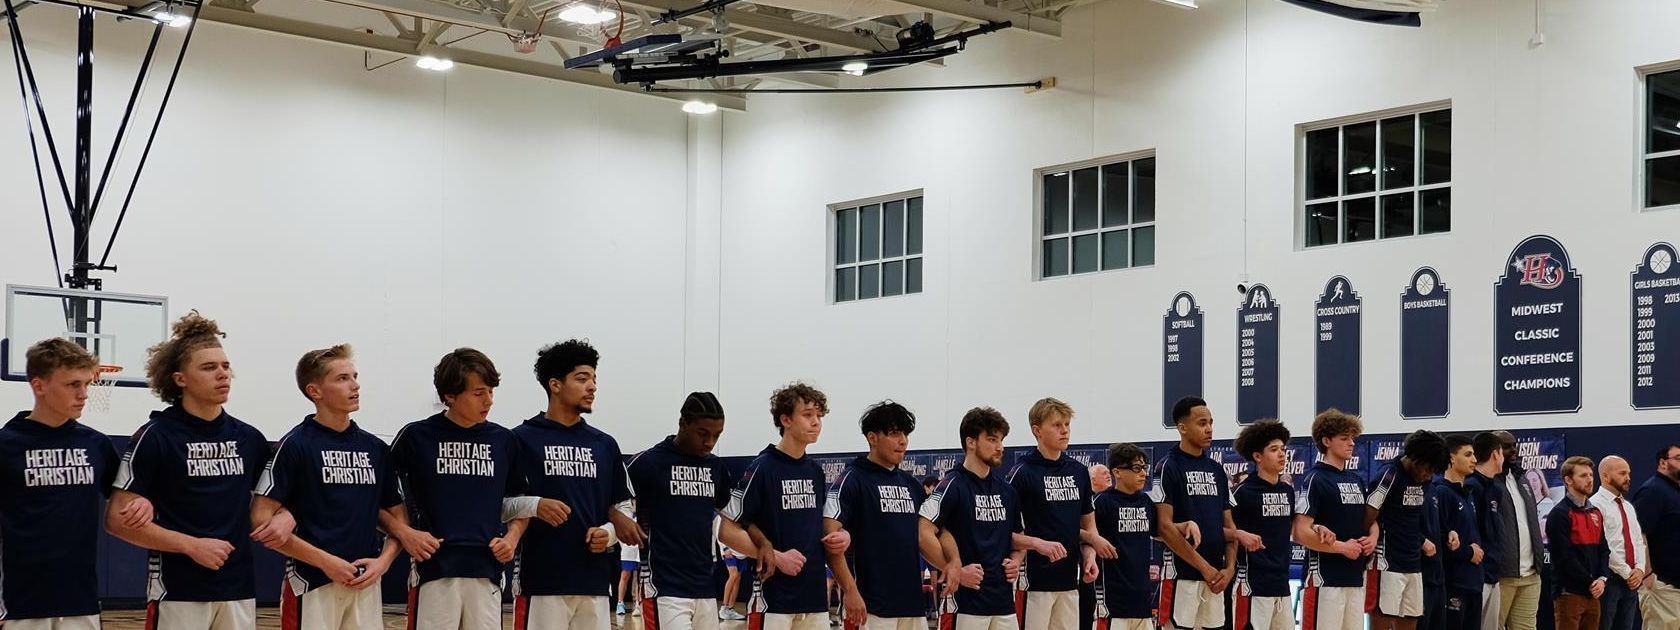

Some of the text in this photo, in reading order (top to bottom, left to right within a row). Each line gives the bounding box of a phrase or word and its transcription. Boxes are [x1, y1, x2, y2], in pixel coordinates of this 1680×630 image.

[1635, 280, 1650, 289] GIRLS
[1404, 299, 1446, 309] BOYS BASKETBALL
[1664, 293, 1680, 303] 2013
[1317, 305, 1360, 316] CROSS COUNTRY
[1511, 303, 1563, 316] MIDWEST
[1637, 307, 1653, 317] 1999
[1172, 320, 1195, 329] SOFTBALL
[1244, 313, 1272, 323] WRESTLING
[1637, 319, 1655, 329] 2000
[1242, 329, 1254, 337] 2000
[1514, 328, 1559, 341] CLASSIC
[1637, 330, 1653, 340] 2001
[1242, 339, 1254, 347] 2004
[1637, 342, 1655, 352] 2003
[1242, 348, 1254, 357] 2005
[1501, 352, 1574, 366] CONFERENCE
[1637, 353, 1655, 363] 2009
[1242, 368, 1254, 376] 2007
[1637, 365, 1651, 375] 2011
[1504, 377, 1570, 390] CHAMPIONS
[1637, 377, 1653, 387] 2012
[187, 441, 240, 459] HERITAGE
[439, 442, 491, 460] HERITAGE
[544, 446, 594, 463] HERITAGE
[1374, 446, 1399, 460] JENNA
[1516, 442, 1540, 456] ISON
[26, 448, 90, 468] HERITAGE
[321, 450, 373, 468] HERITAGE
[1521, 454, 1558, 470] GROOMS
[187, 457, 244, 477] CHRISTIAN
[436, 458, 494, 477] CHRISTIAN
[544, 460, 597, 479] CHRISTIAN
[671, 465, 712, 483] HERITAGE
[1279, 461, 1304, 474] ELVER
[24, 466, 94, 487] CHRISTIAN
[322, 467, 376, 485] CHRISTIAN
[1044, 475, 1076, 489] HERITAGE
[670, 480, 715, 498] CHRISTIAN
[781, 479, 815, 495] HERITAGE
[878, 485, 912, 500] HERITAGE
[1045, 487, 1080, 501] CHRISTIAN
[782, 494, 816, 510] CHRISTIAN
[880, 499, 915, 514] CHRISTIAN
[1118, 507, 1147, 520] HERITAGE
[1118, 519, 1149, 533] CHRISTIAN
